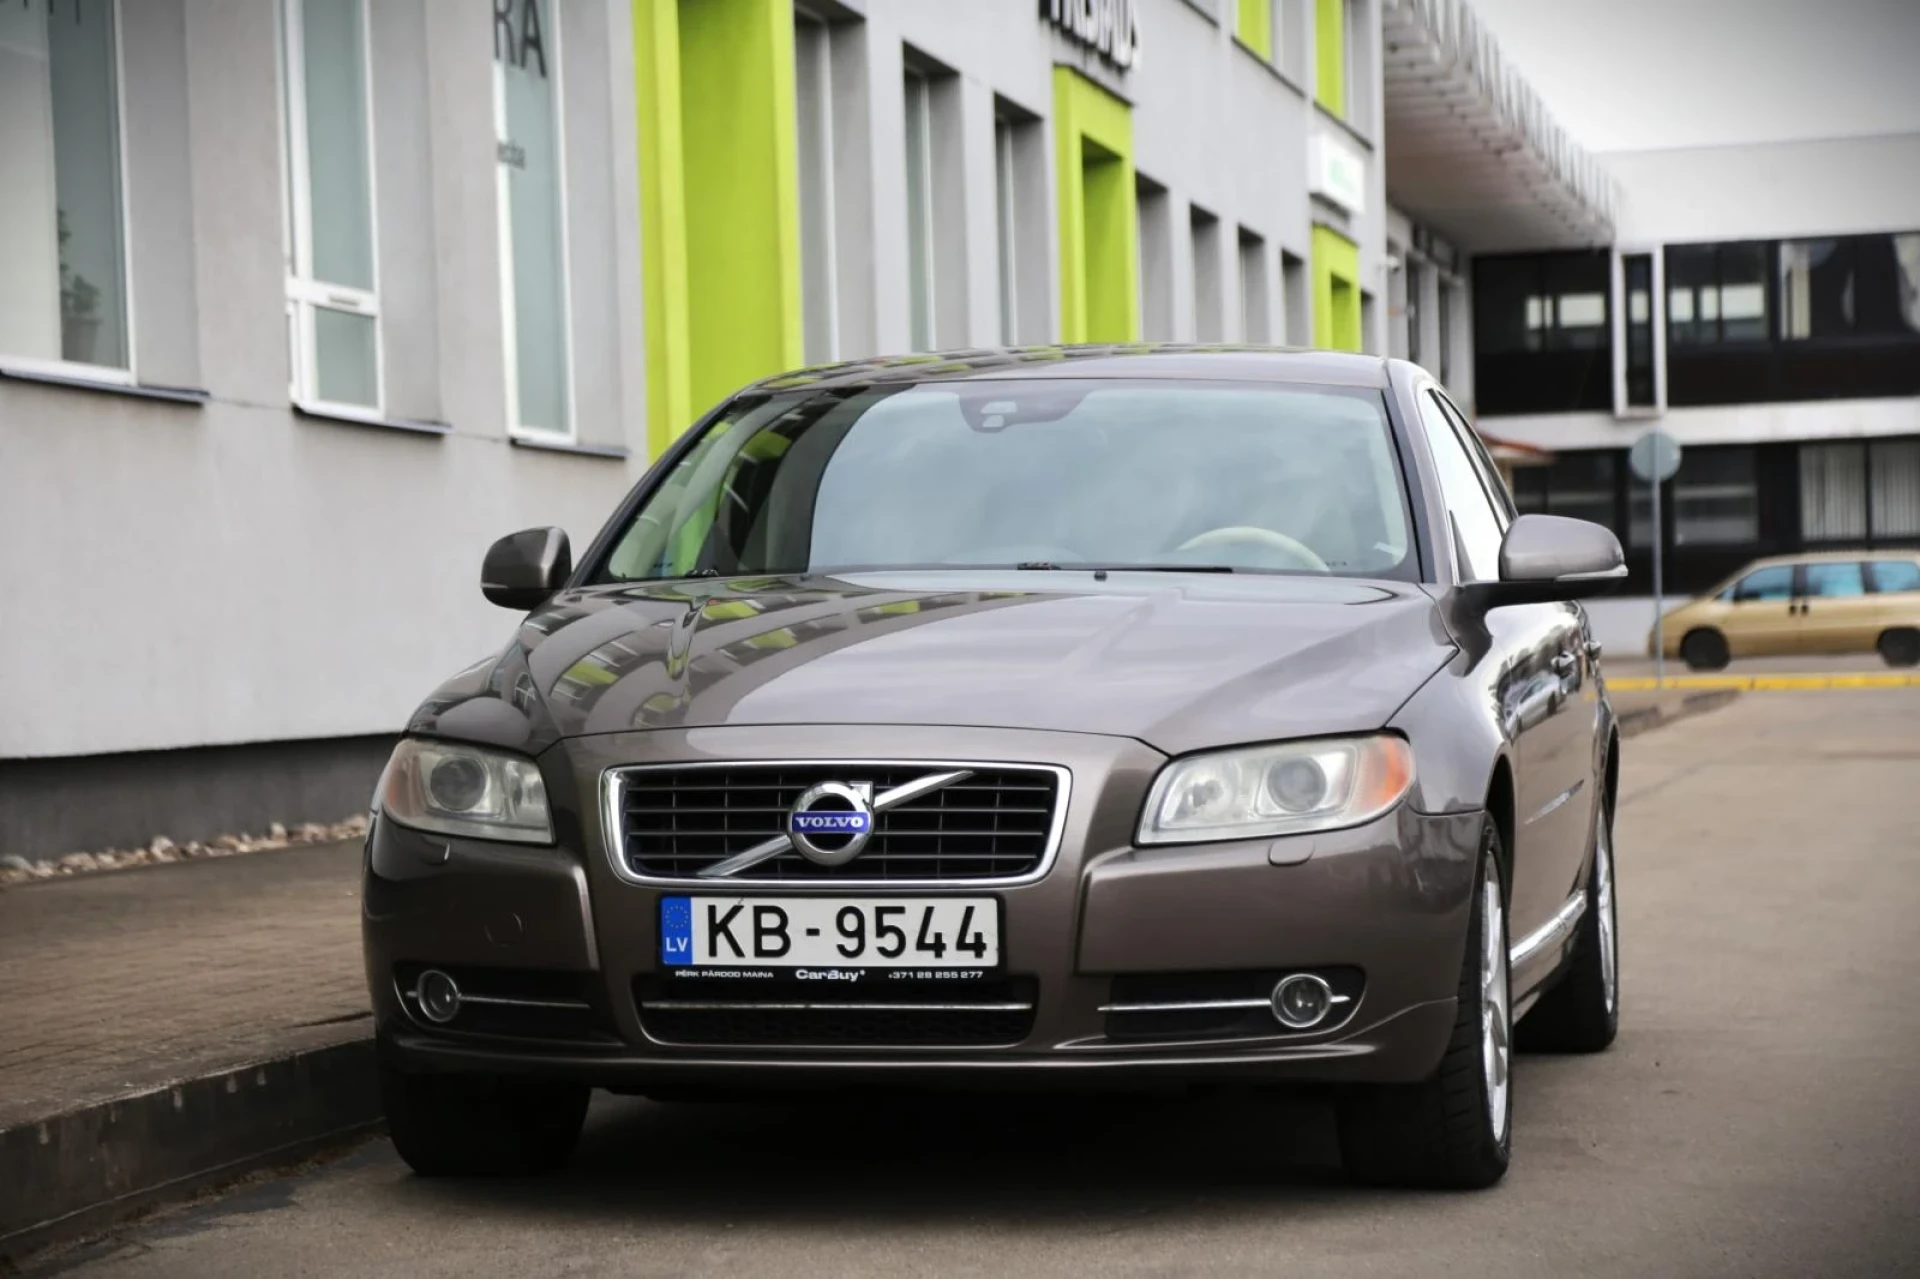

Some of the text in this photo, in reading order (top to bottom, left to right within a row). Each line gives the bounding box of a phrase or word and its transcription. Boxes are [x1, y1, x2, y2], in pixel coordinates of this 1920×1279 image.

[795, 816, 864, 829] VOLVO
[707, 904, 988, 960] KB-9544
[665, 937, 689, 953] LV
